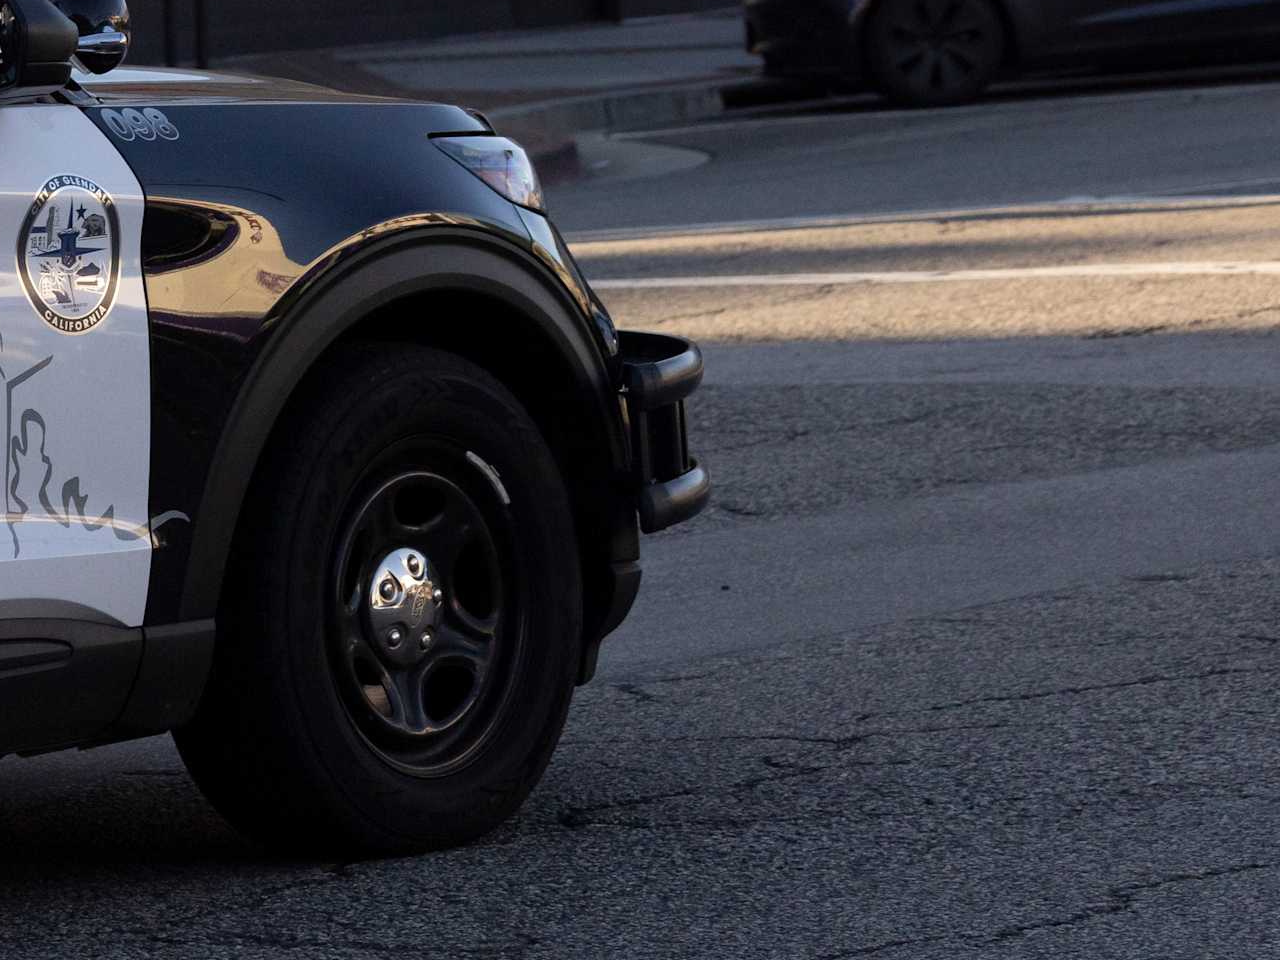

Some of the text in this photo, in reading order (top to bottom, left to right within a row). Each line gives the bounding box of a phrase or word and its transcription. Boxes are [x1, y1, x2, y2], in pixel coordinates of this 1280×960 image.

[100, 107, 180, 142] 098
[48, 179, 62, 192] OF
[44, 304, 107, 332] CALIFORNIA
